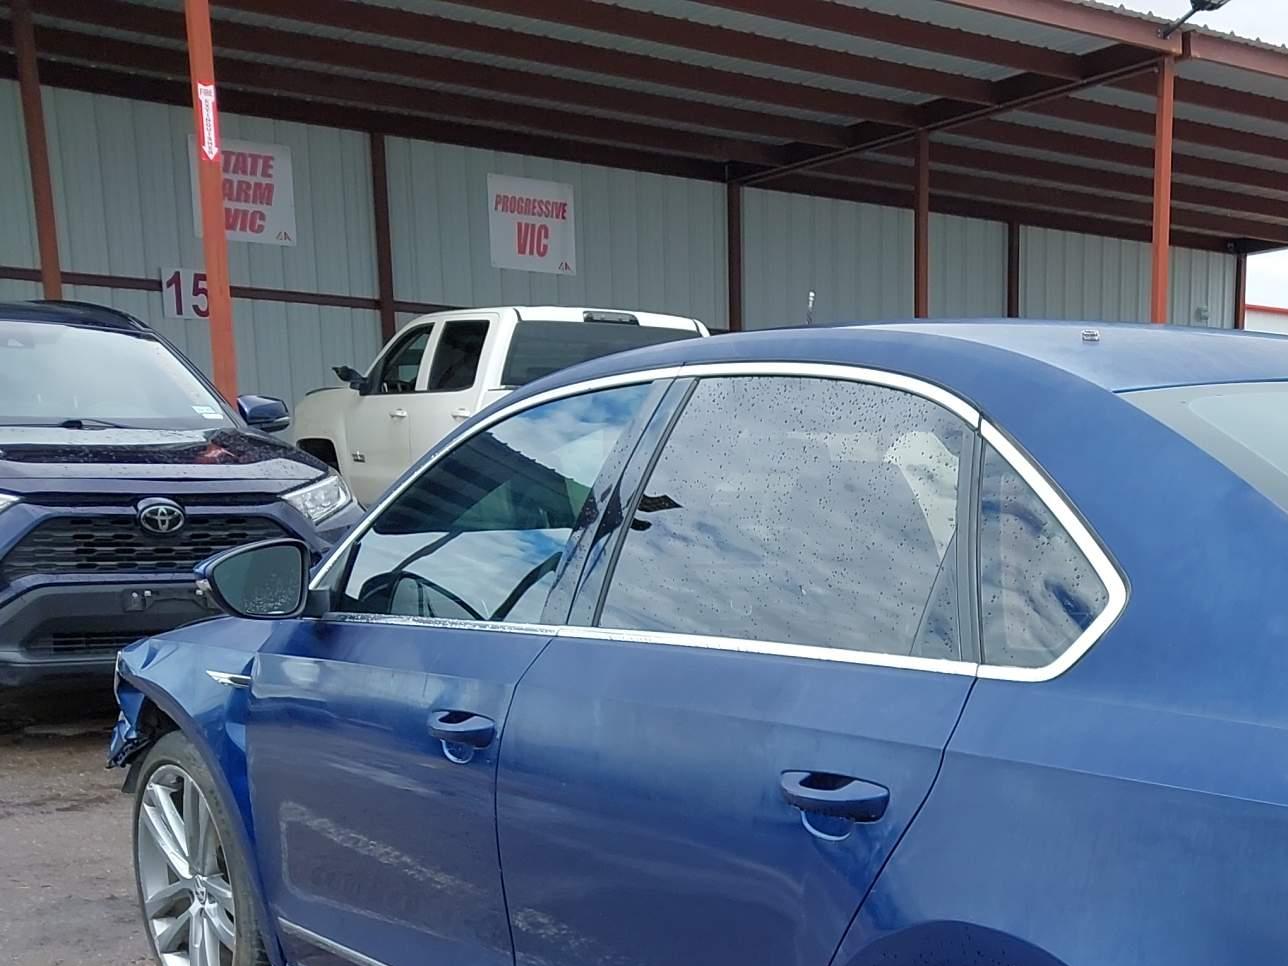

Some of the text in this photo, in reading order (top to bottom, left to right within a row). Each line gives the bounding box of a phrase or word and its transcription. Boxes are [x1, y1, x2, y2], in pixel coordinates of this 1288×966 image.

[220, 150, 275, 179] TATE
[222, 178, 275, 207] ARM
[494, 193, 568, 220] PROGRESSIVE
[224, 206, 267, 235] VIC
[516, 221, 549, 258] VIC
[165, 270, 211, 318] 15
